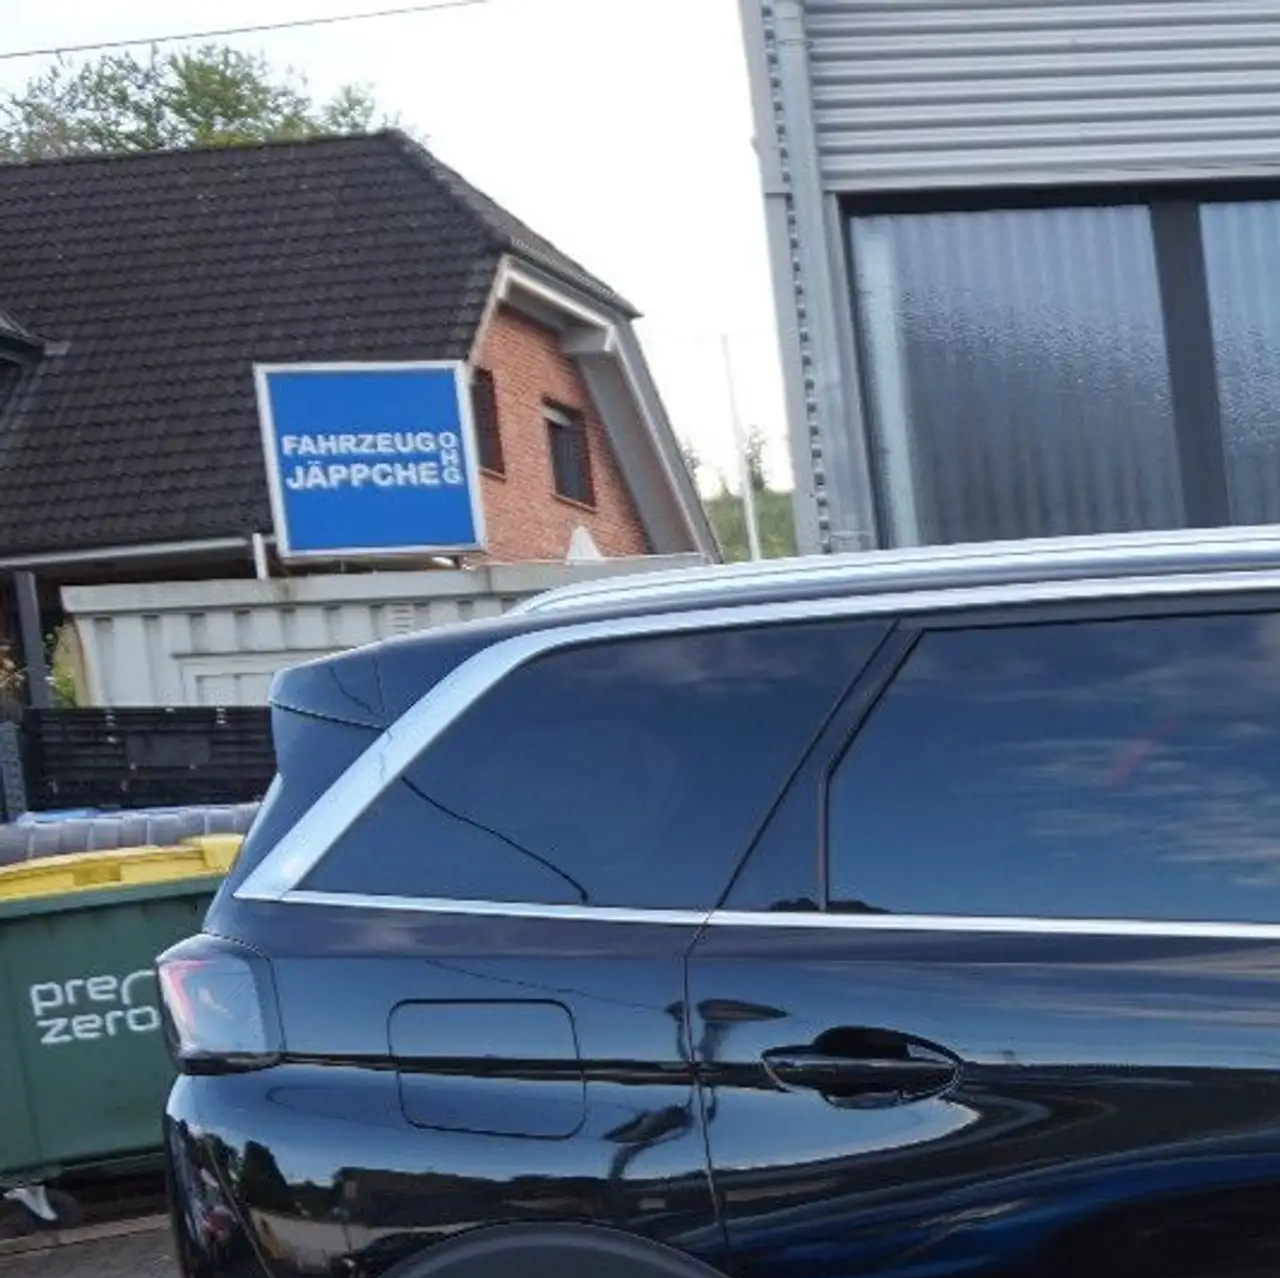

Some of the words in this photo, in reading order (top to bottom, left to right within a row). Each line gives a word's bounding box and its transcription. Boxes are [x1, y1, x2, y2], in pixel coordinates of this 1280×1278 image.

[281, 431, 435, 456] FAHRZEUG
[438, 431, 463, 485] OHG
[285, 460, 440, 490] JÄPPCHE
[36, 1004, 161, 1045] zero
